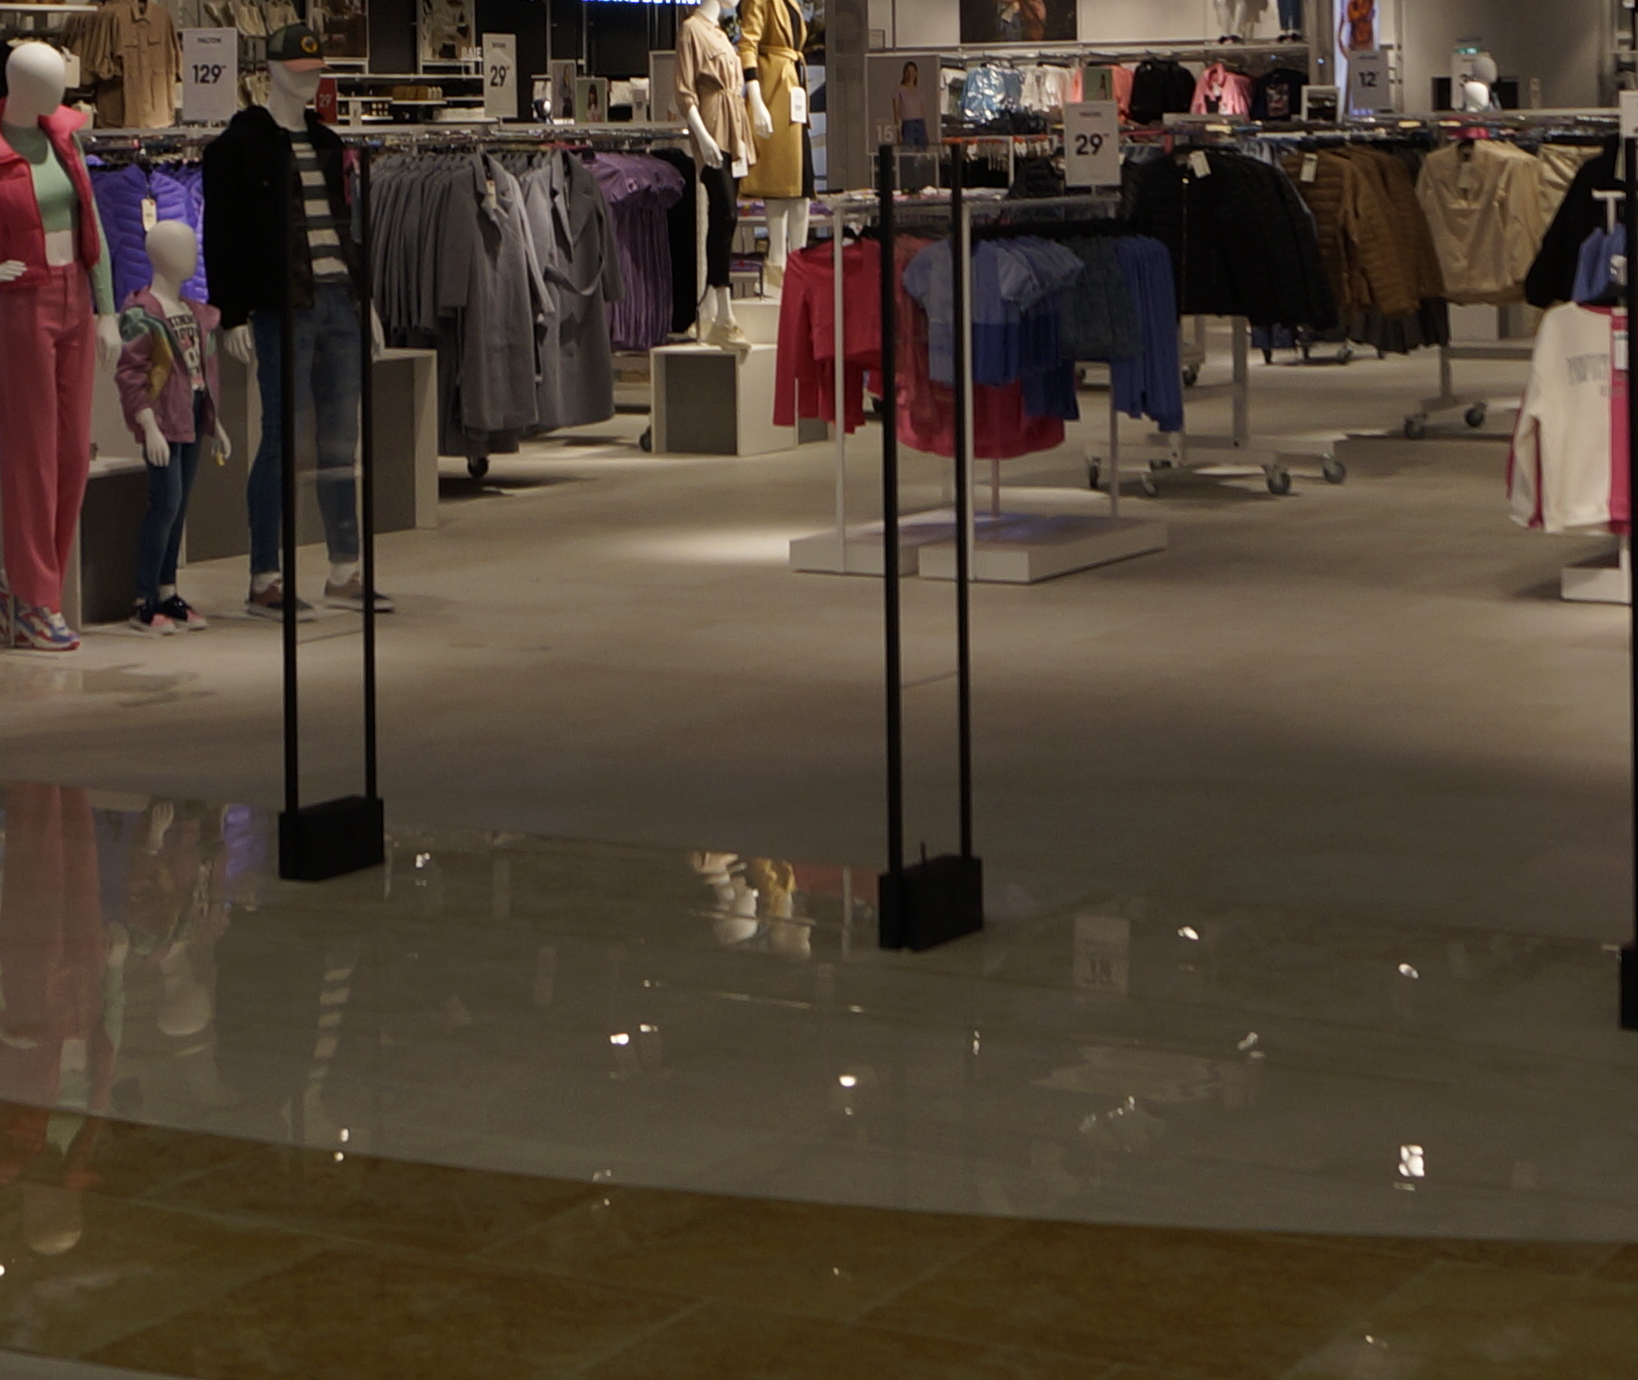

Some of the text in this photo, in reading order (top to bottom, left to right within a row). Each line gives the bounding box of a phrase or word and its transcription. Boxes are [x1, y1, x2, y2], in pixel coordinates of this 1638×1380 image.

[192, 64, 222, 84] 129
[490, 65, 507, 87] 29
[1358, 71, 1377, 87] 12
[1074, 132, 1103, 157] 29
